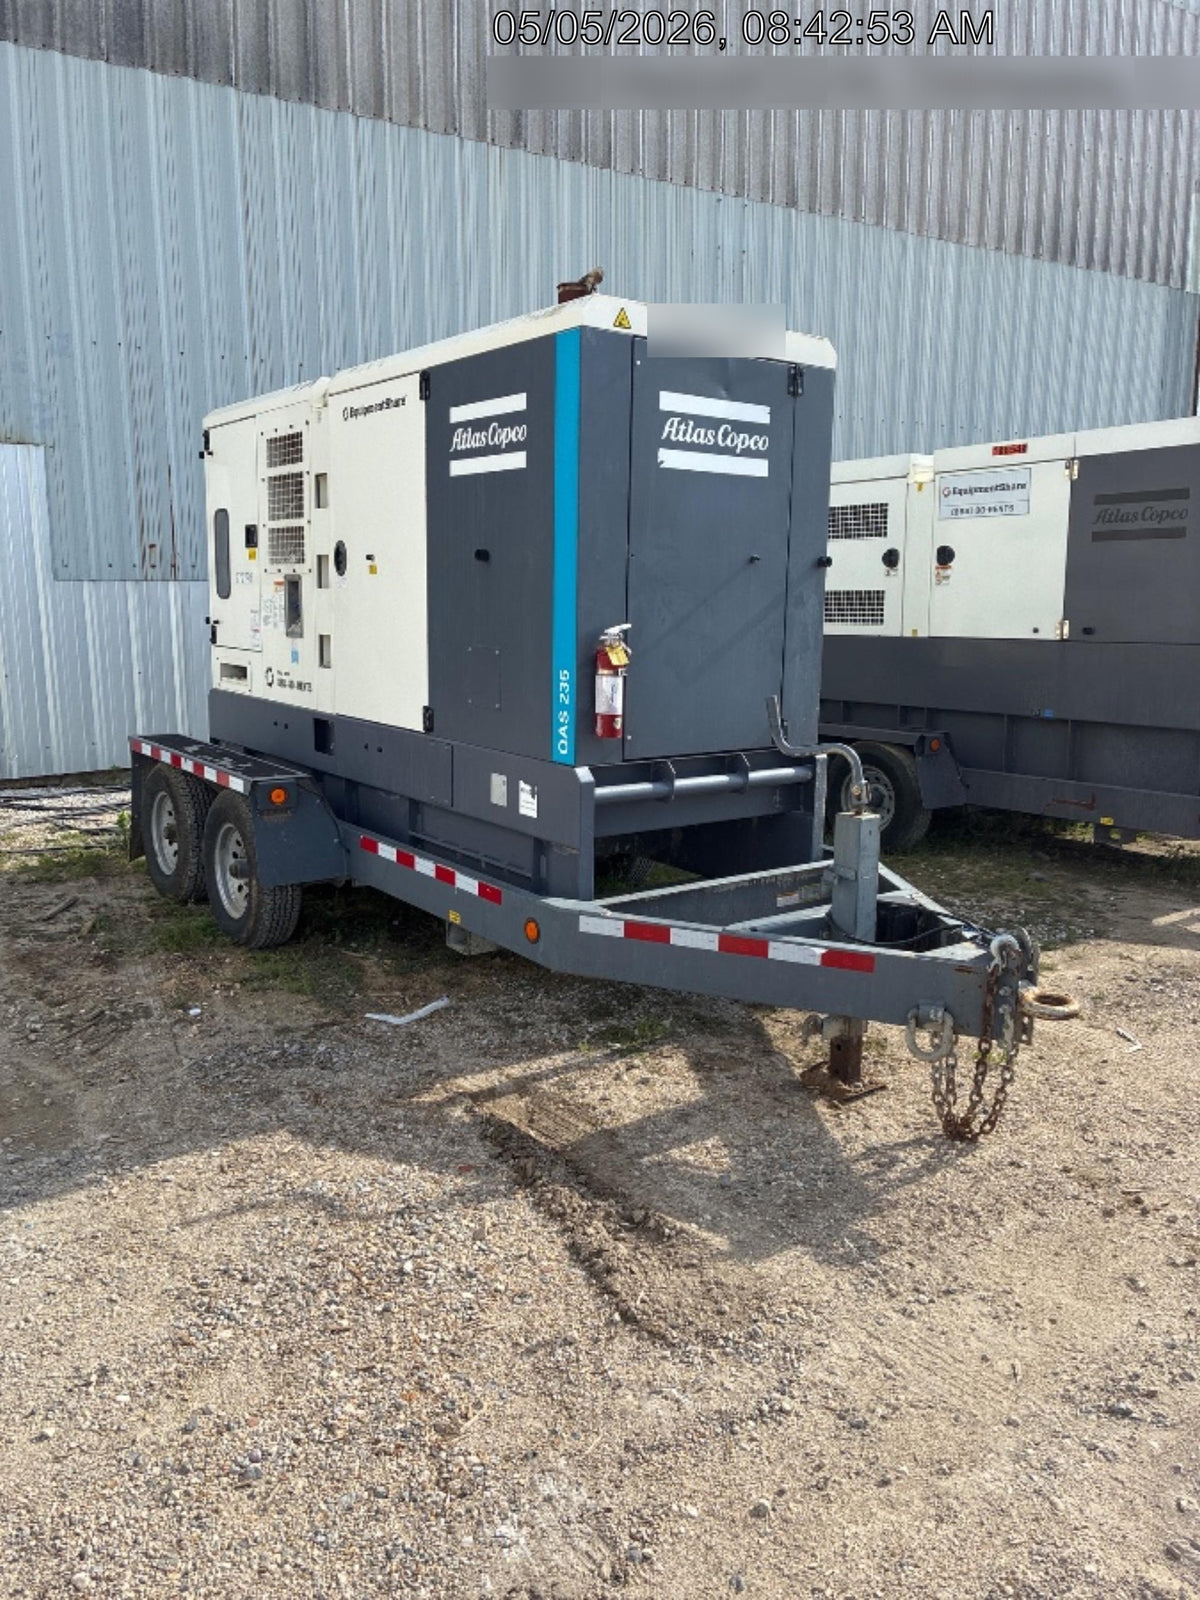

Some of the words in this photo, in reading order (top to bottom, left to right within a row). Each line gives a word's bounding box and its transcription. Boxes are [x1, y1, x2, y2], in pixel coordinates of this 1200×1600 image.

[449, 428, 487, 452] Atlas
[488, 422, 527, 449] Copco
[661, 417, 715, 446] Atlas
[717, 424, 769, 454] Copco
[1092, 507, 1139, 525] Atlas
[1141, 506, 1189, 524] Copco
[560, 669, 570, 705] 235
